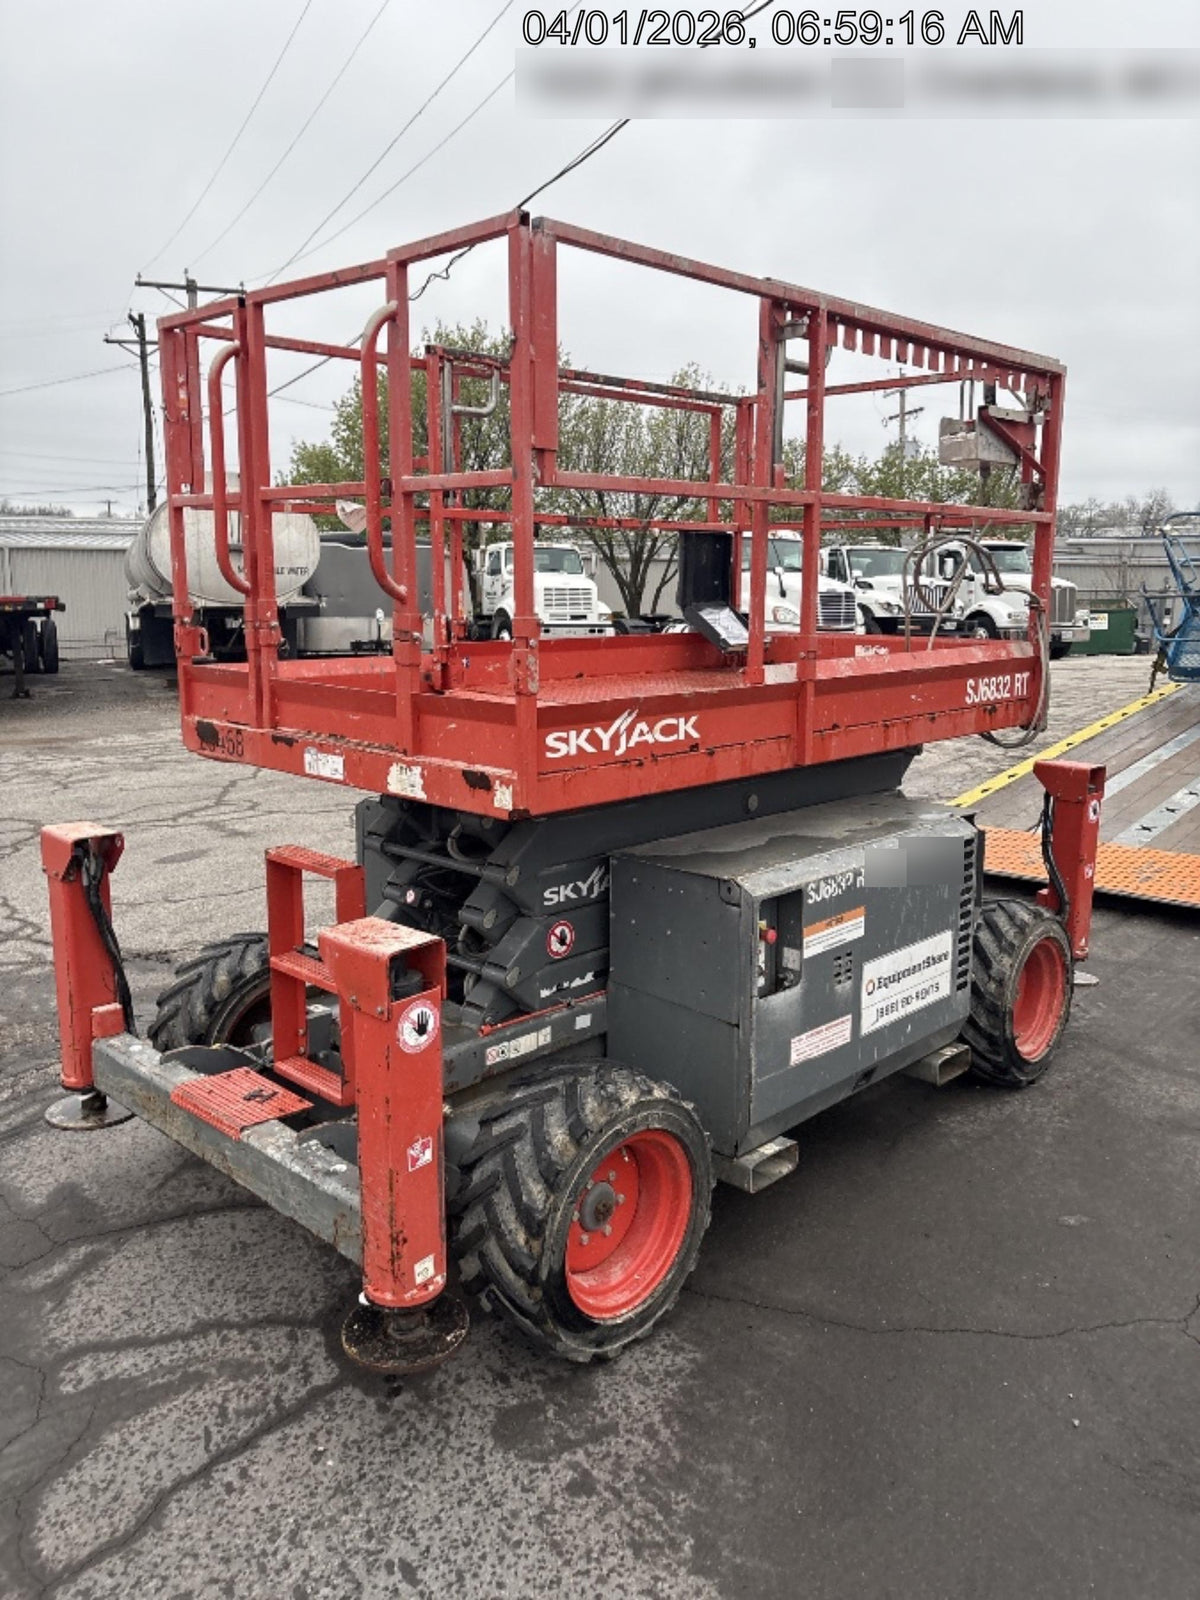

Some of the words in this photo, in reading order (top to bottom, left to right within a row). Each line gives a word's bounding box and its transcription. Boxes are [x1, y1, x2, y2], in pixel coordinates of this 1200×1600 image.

[965, 675, 1011, 704] SJ6832
[1014, 672, 1030, 697] RT
[545, 709, 700, 758] SKYJACK
